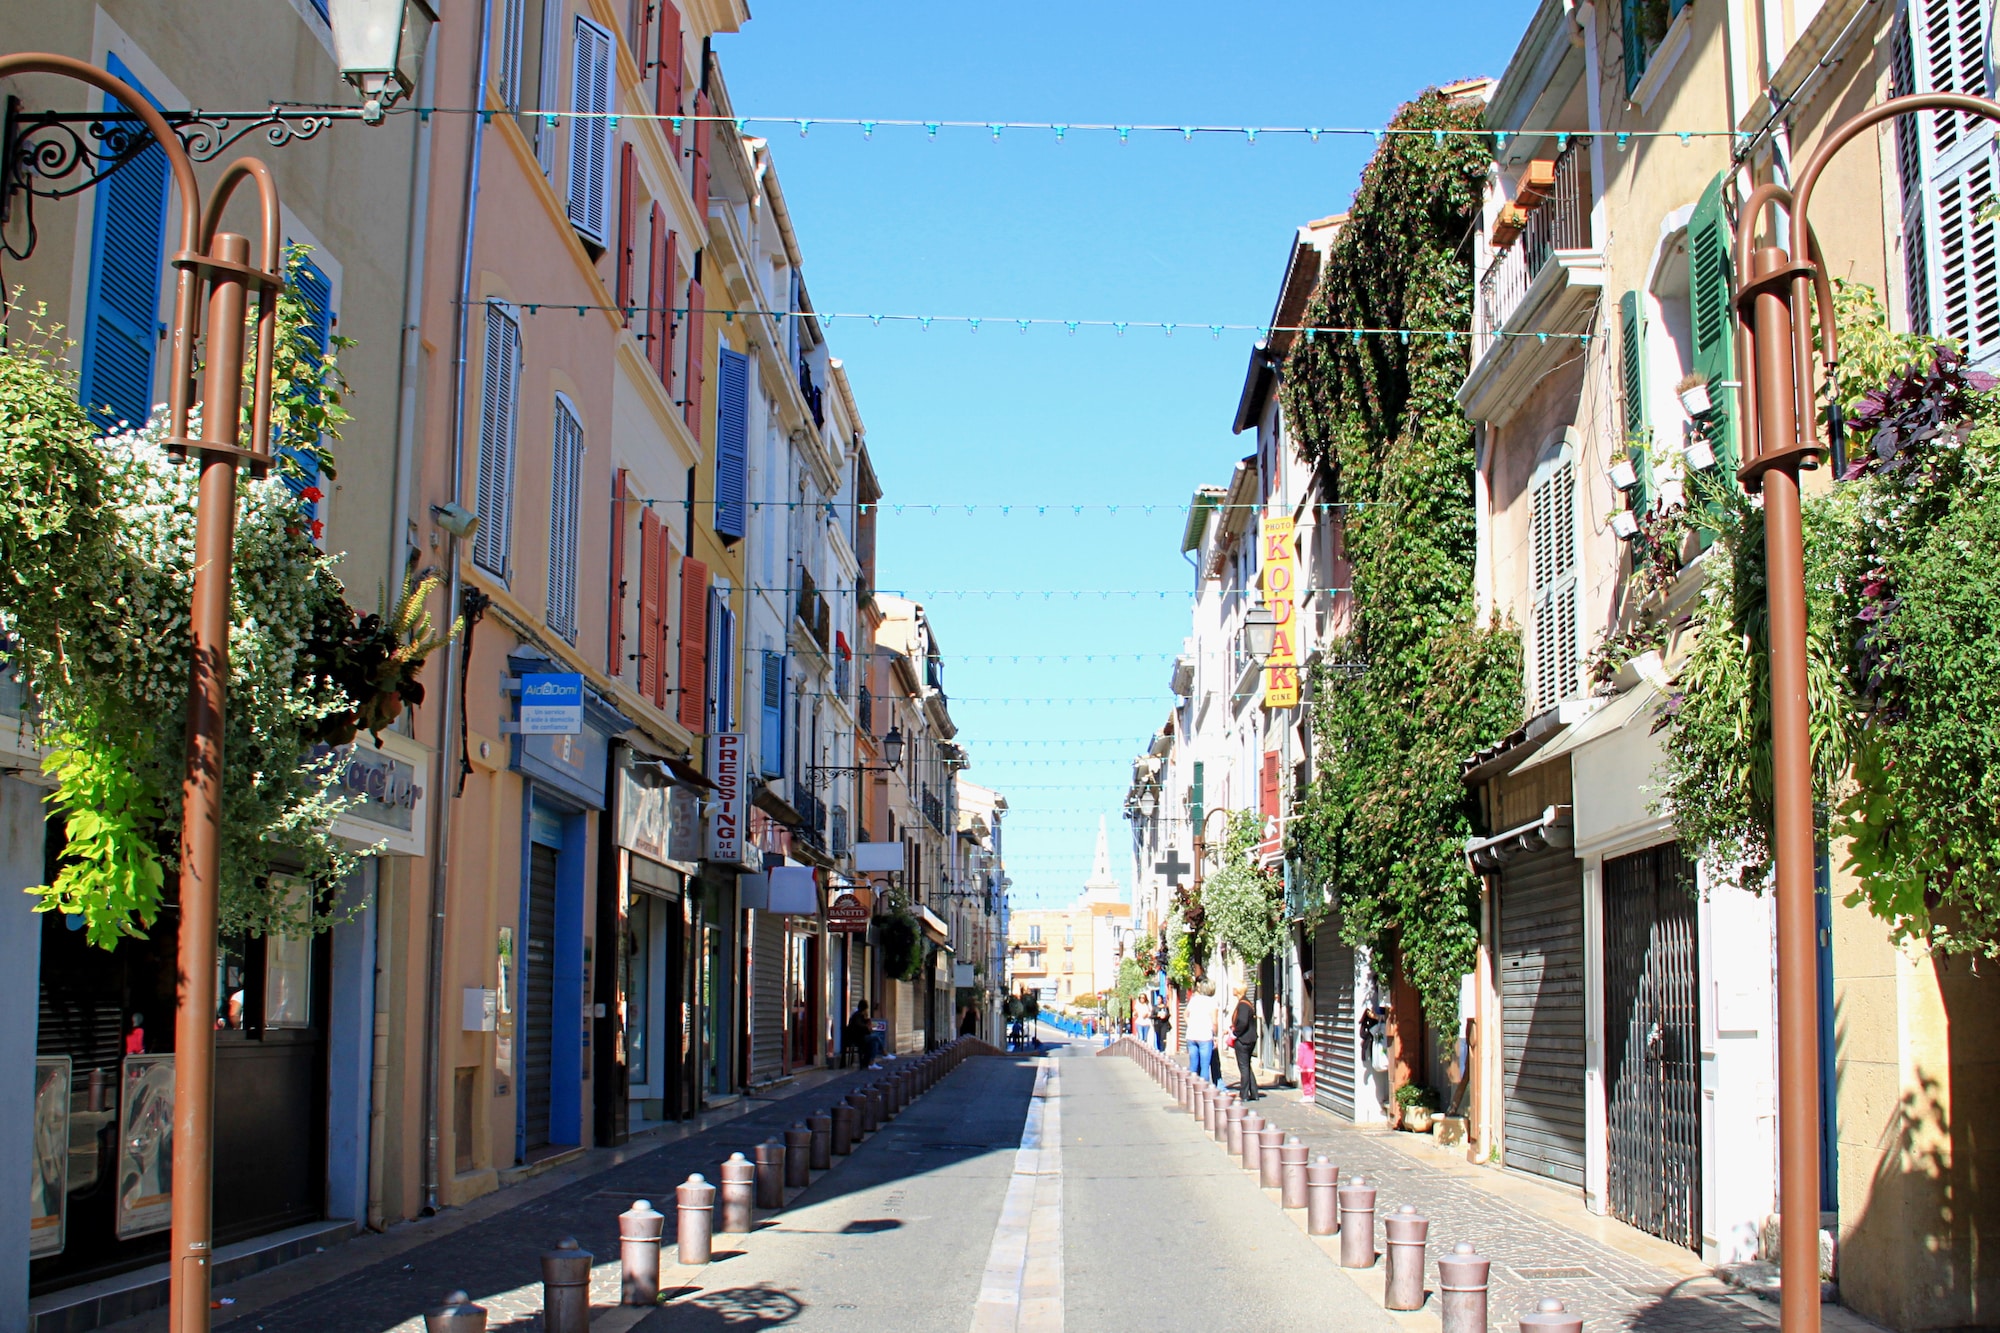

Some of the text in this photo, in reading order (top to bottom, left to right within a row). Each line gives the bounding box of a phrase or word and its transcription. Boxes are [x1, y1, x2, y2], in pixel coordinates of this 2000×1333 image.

[1265, 522, 1291, 531] PHOTO
[1266, 533, 1293, 689] KODAK
[1271, 693, 1291, 701] CINE
[717, 736, 738, 839] PRESSING
[718, 841, 732, 849] DE
[714, 850, 737, 859] L'ILE
[830, 909, 865, 917] BANETTE
